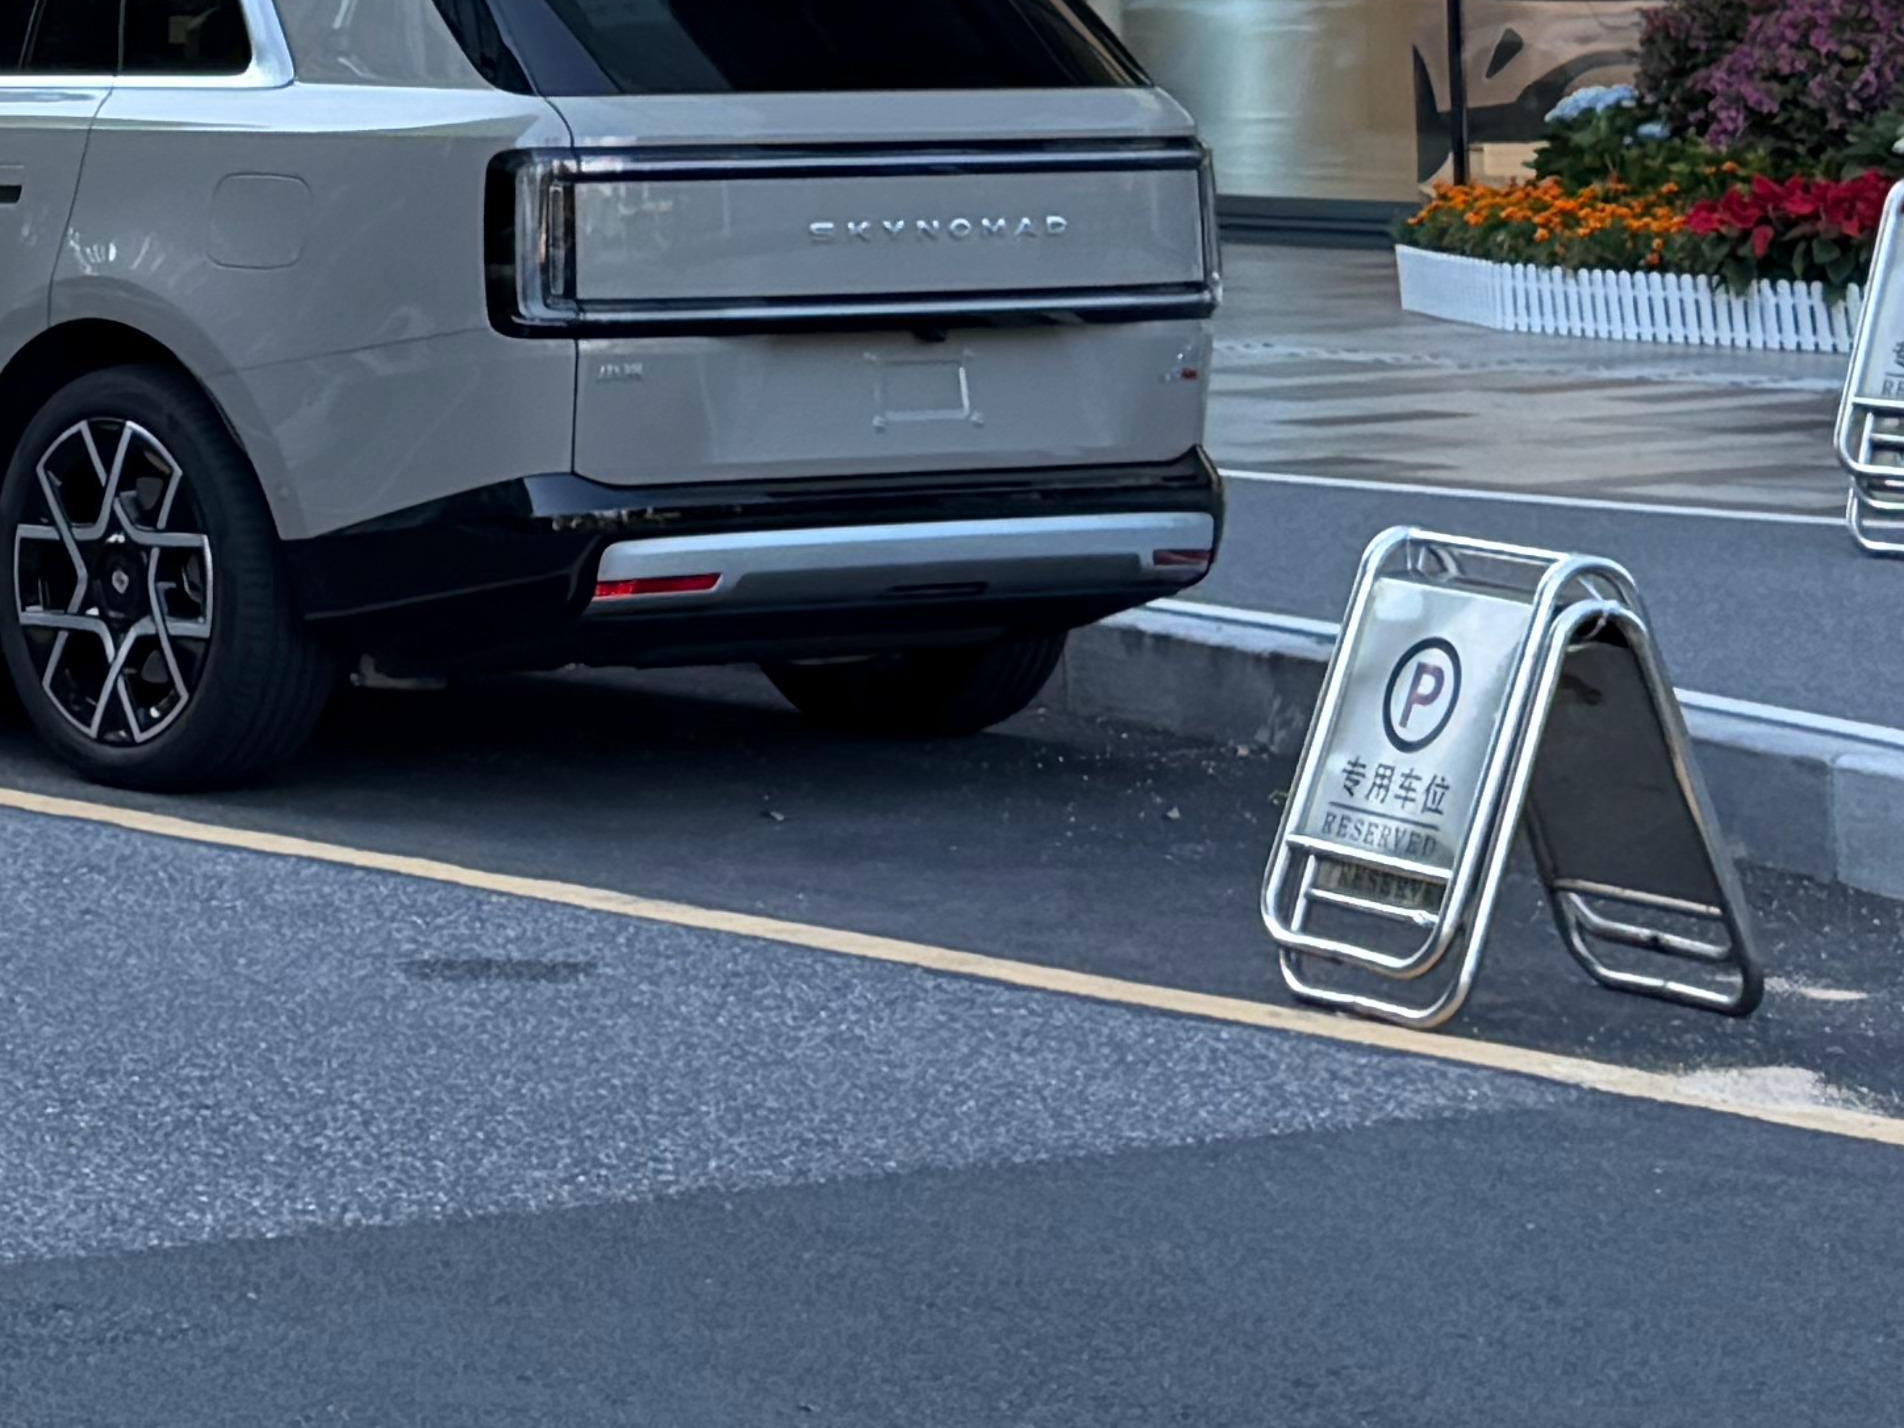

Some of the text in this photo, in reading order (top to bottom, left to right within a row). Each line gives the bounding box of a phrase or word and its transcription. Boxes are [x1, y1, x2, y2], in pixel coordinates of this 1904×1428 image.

[808, 215, 1068, 242] SKYNOMAD
[1340, 754, 1451, 816] 专用车位
[1321, 810, 1440, 860] RESERVED
